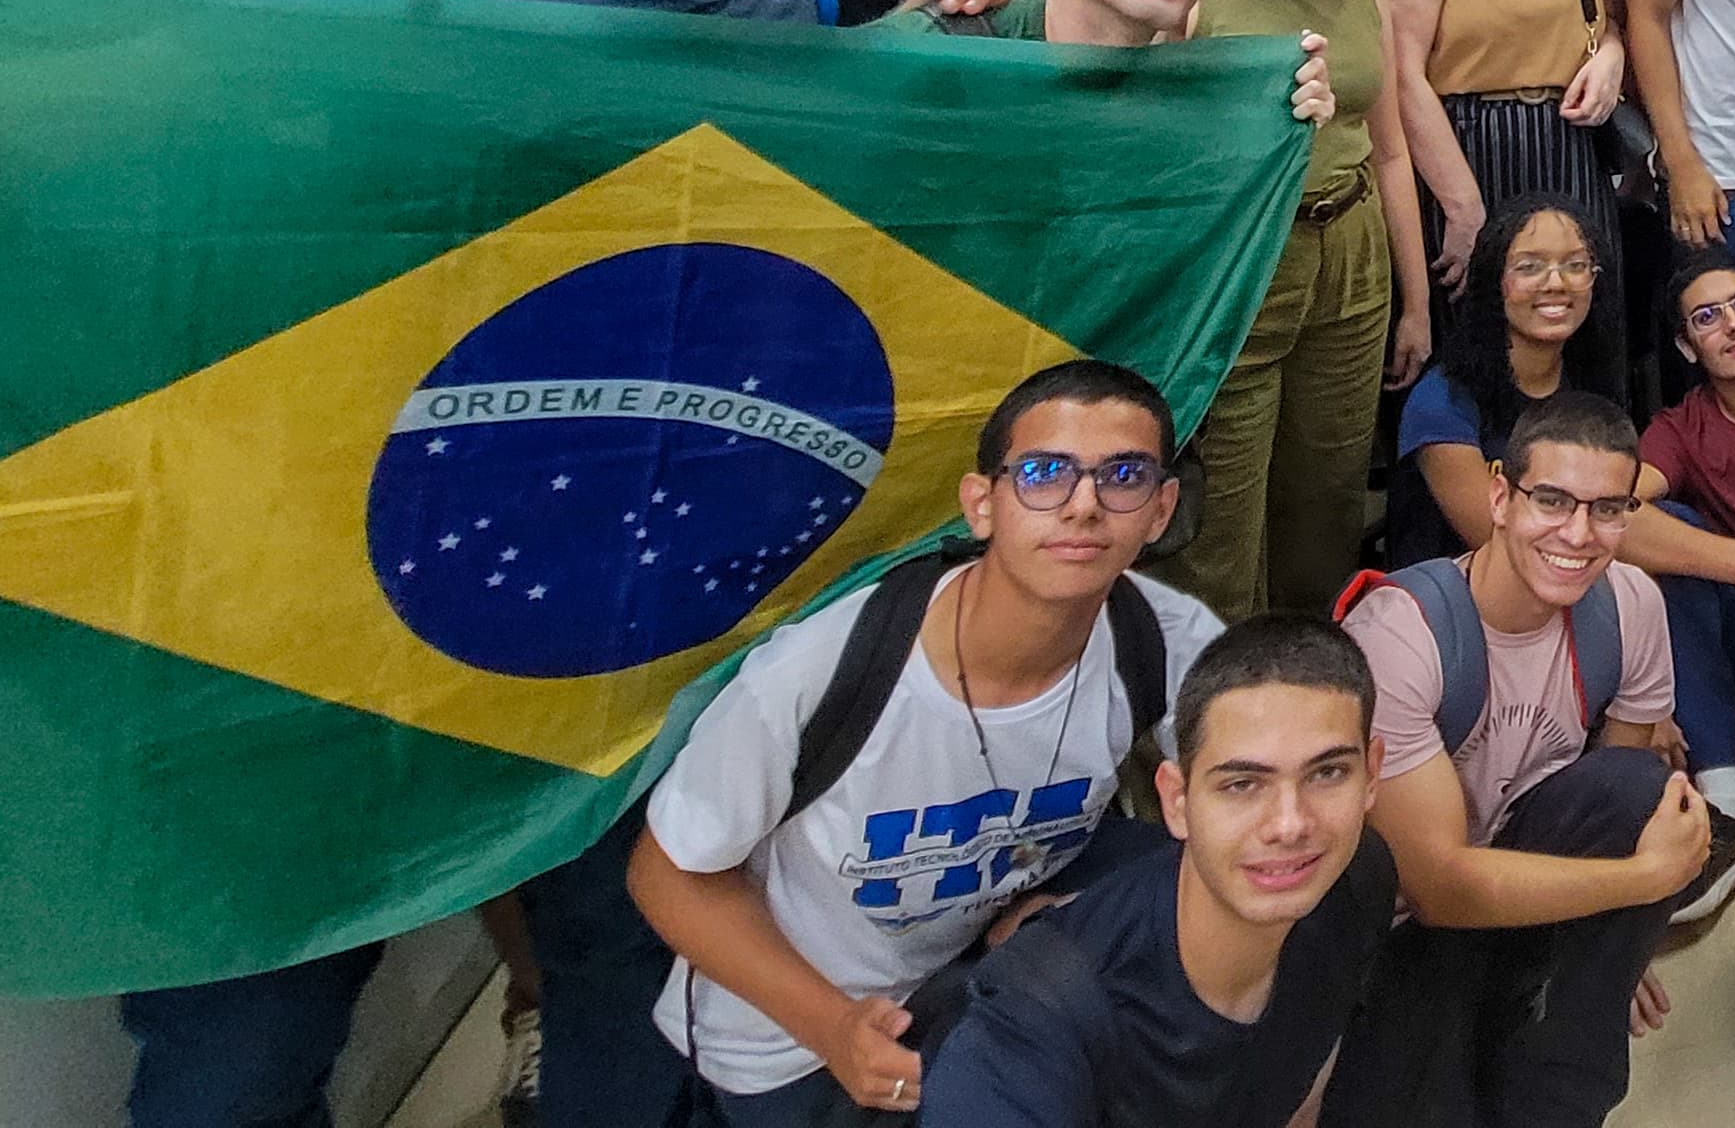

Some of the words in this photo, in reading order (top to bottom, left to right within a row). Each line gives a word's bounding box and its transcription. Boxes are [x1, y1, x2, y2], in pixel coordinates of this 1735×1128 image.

[427, 386, 602, 421] ORDEM
[617, 386, 644, 412] E
[654, 389, 869, 471] PROGRESSO
[852, 777, 1092, 908] ITA
